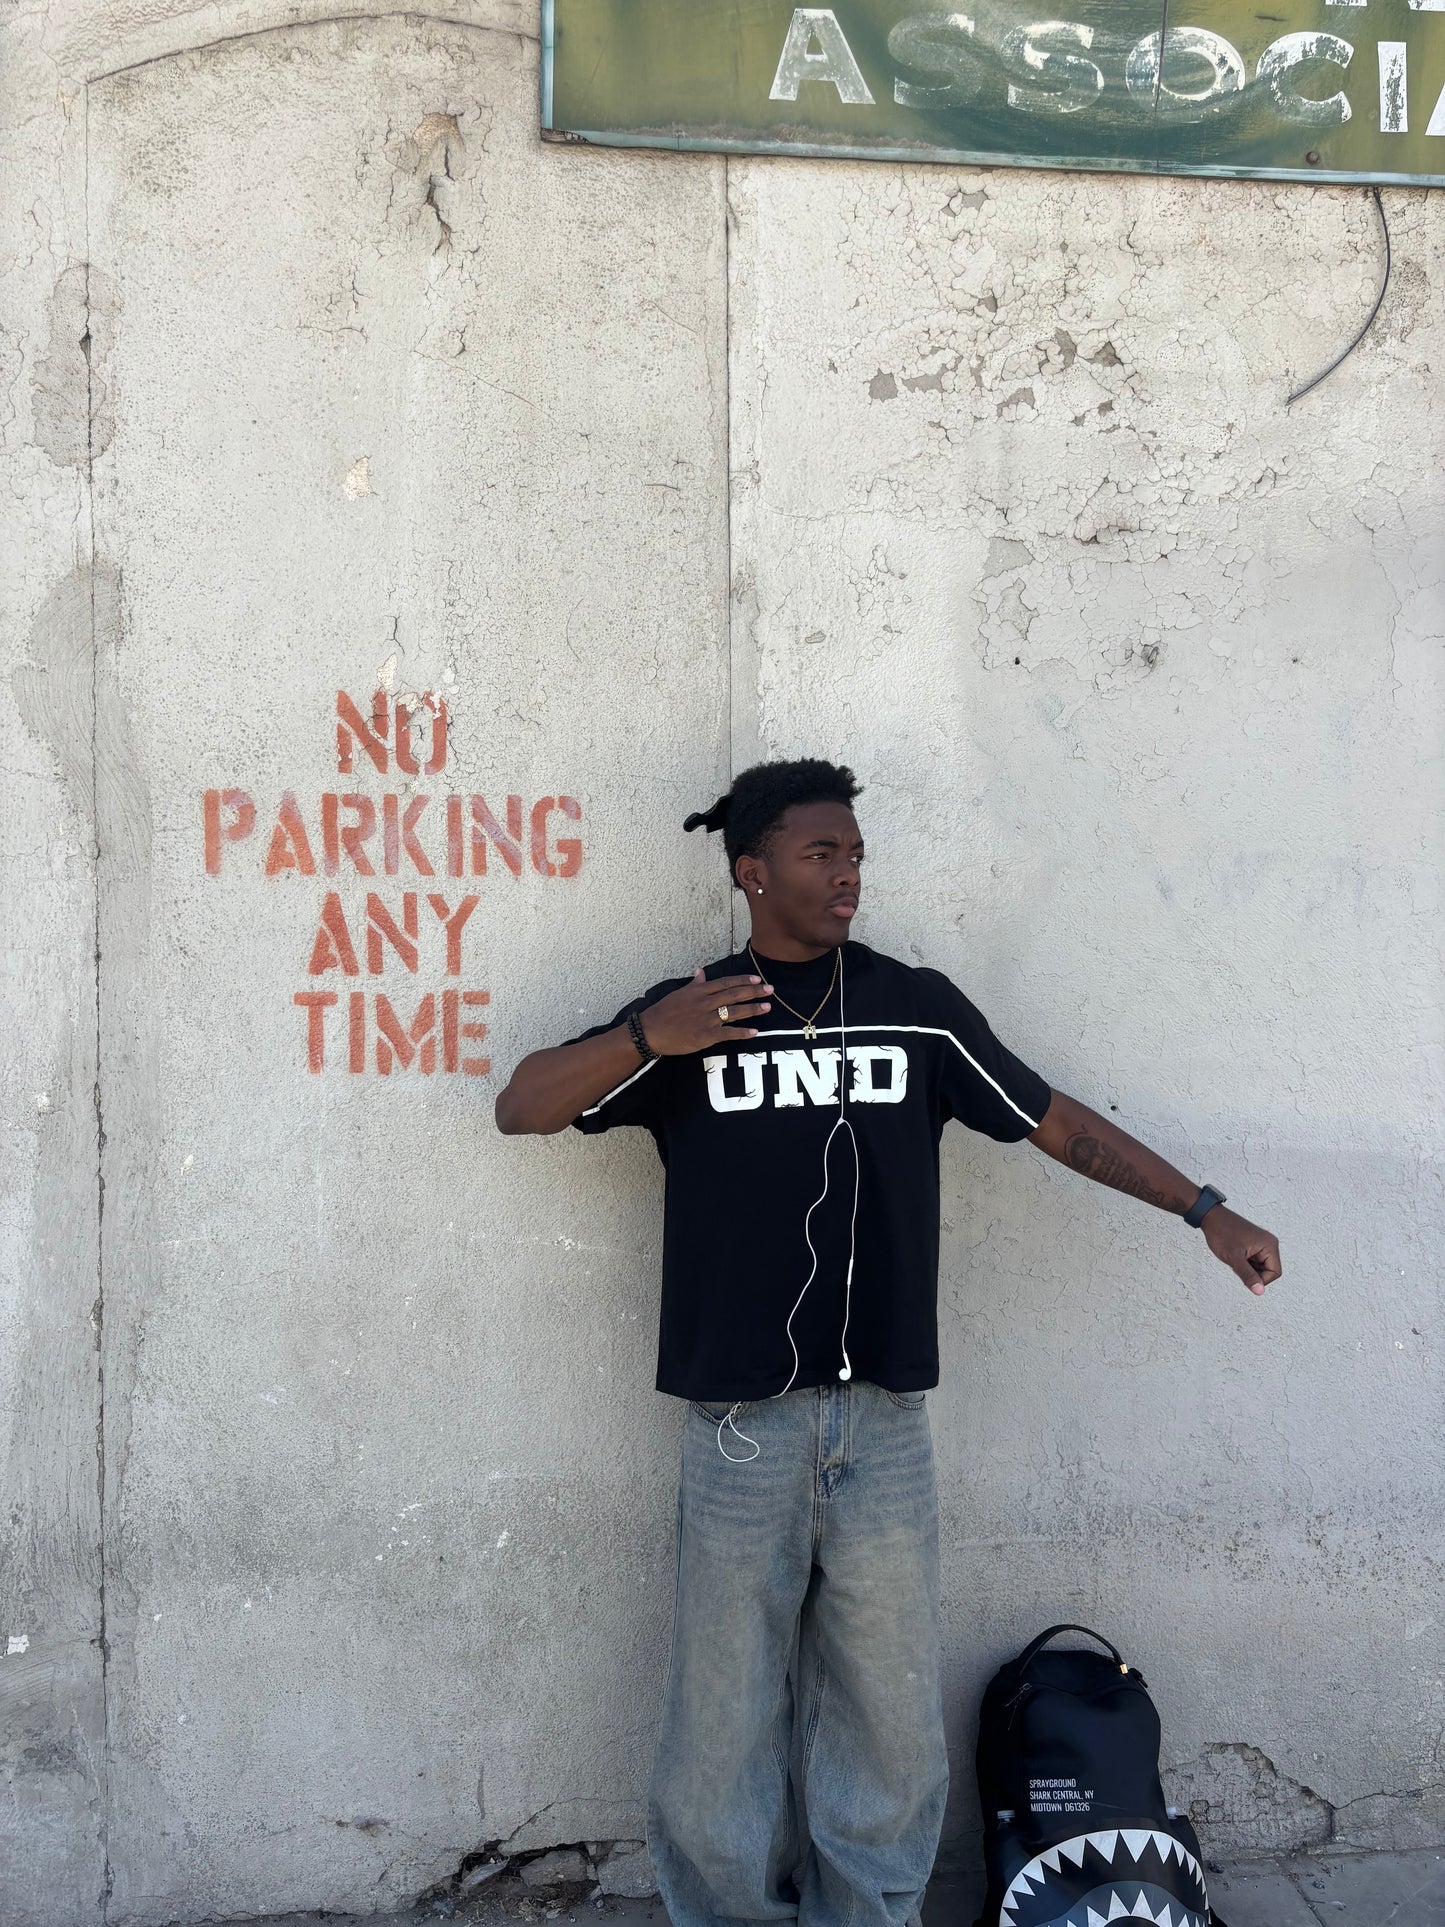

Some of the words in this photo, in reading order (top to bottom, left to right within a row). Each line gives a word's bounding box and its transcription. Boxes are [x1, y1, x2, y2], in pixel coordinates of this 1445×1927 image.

[769, 8, 1445, 137] ASSOCI
[336, 689, 447, 775] NO
[204, 788, 583, 878] PARKING
[308, 892, 481, 976] ANY
[294, 989, 491, 1076] TIME
[703, 1045, 908, 1113] UND
[1029, 1778, 1076, 1788] SPRAYGROUND
[1029, 1790, 1051, 1800] SHARK
[1084, 1789, 1094, 1799] NY
[1030, 1802, 1062, 1811] MIDTOWN
